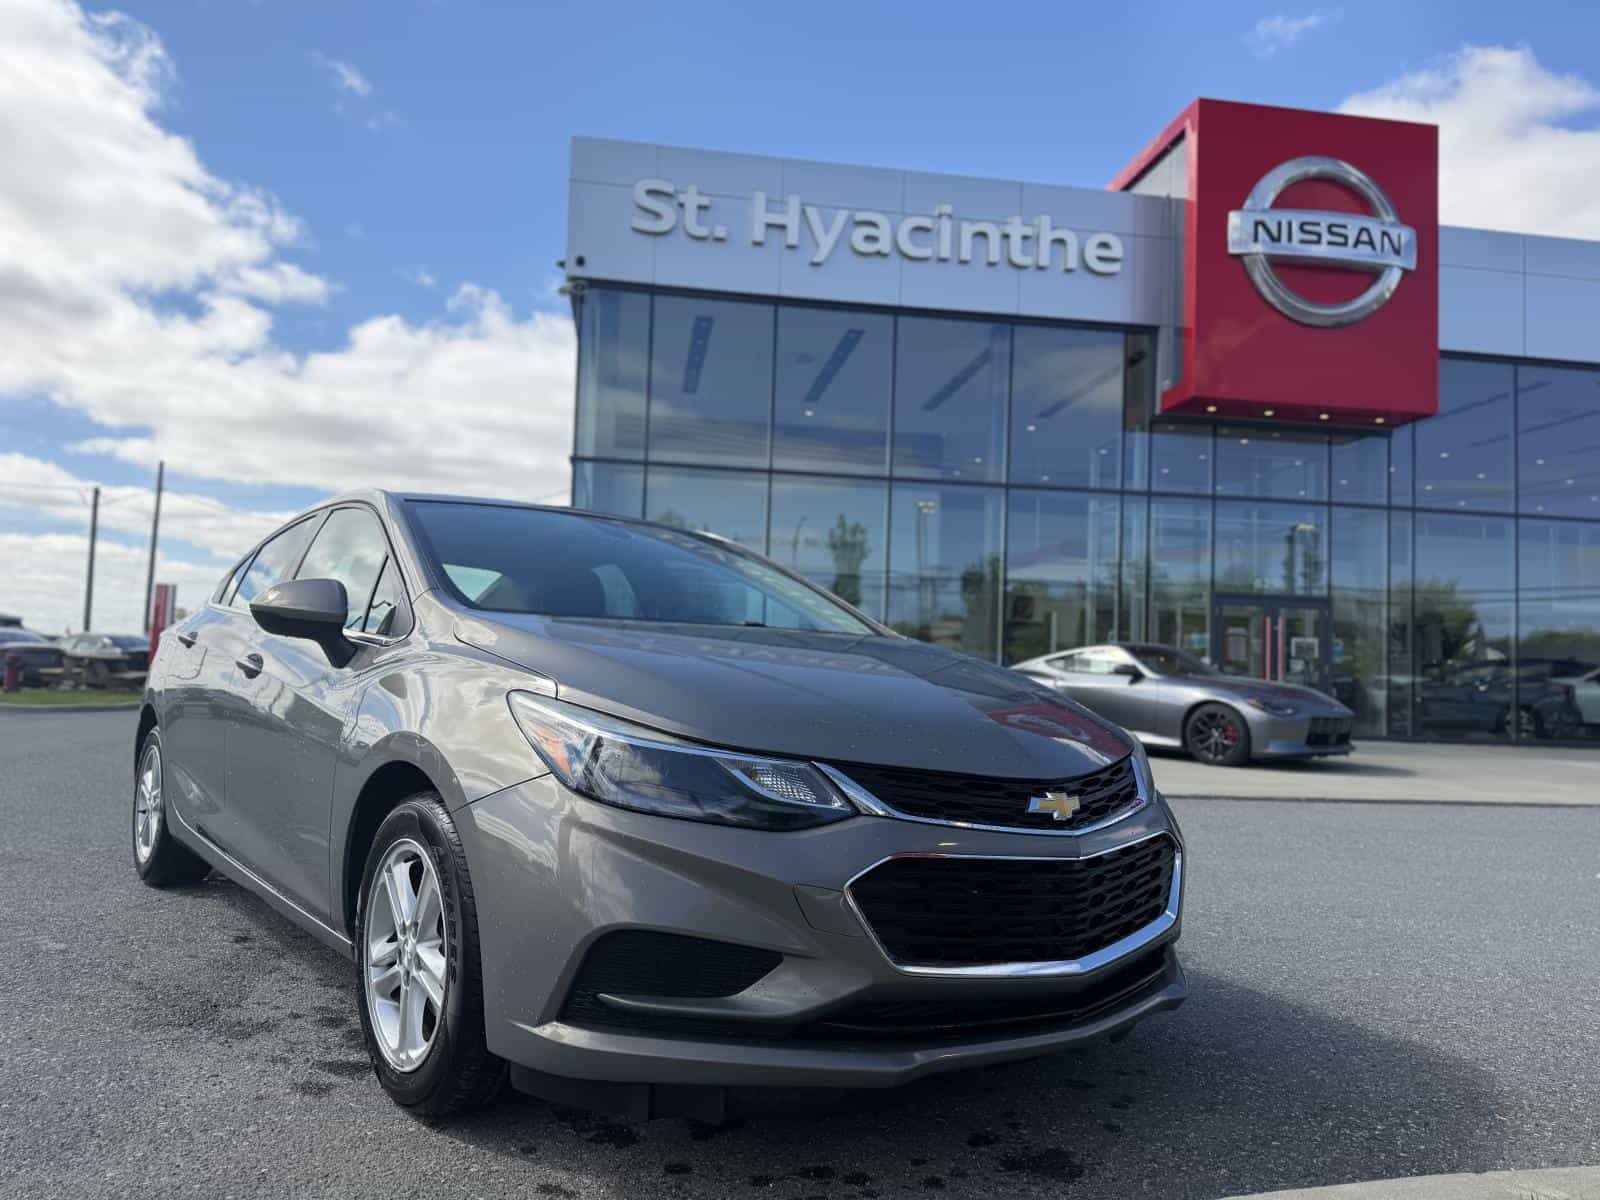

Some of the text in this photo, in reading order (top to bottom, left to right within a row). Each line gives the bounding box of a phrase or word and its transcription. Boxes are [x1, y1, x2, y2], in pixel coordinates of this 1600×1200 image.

[631, 179, 1124, 276] St. Hyacinthe
[1253, 221, 1402, 256] NISSAN
